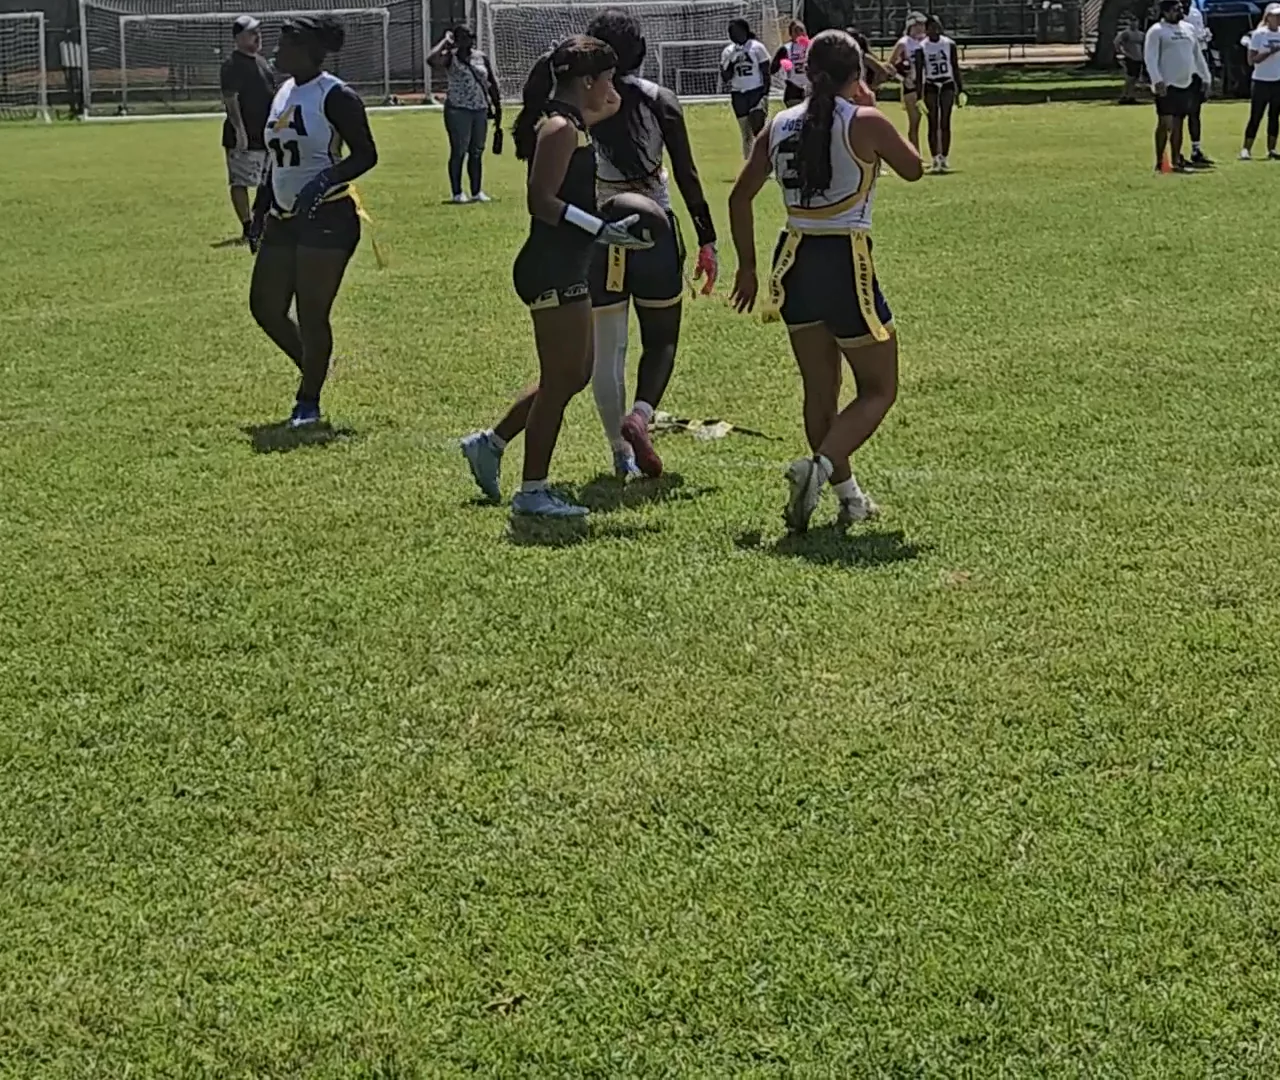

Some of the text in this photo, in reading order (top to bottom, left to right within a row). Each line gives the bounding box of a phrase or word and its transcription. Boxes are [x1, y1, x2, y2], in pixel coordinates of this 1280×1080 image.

[736, 65, 753, 76] 12
[930, 62, 948, 75] 30
[268, 138, 300, 167] 11
